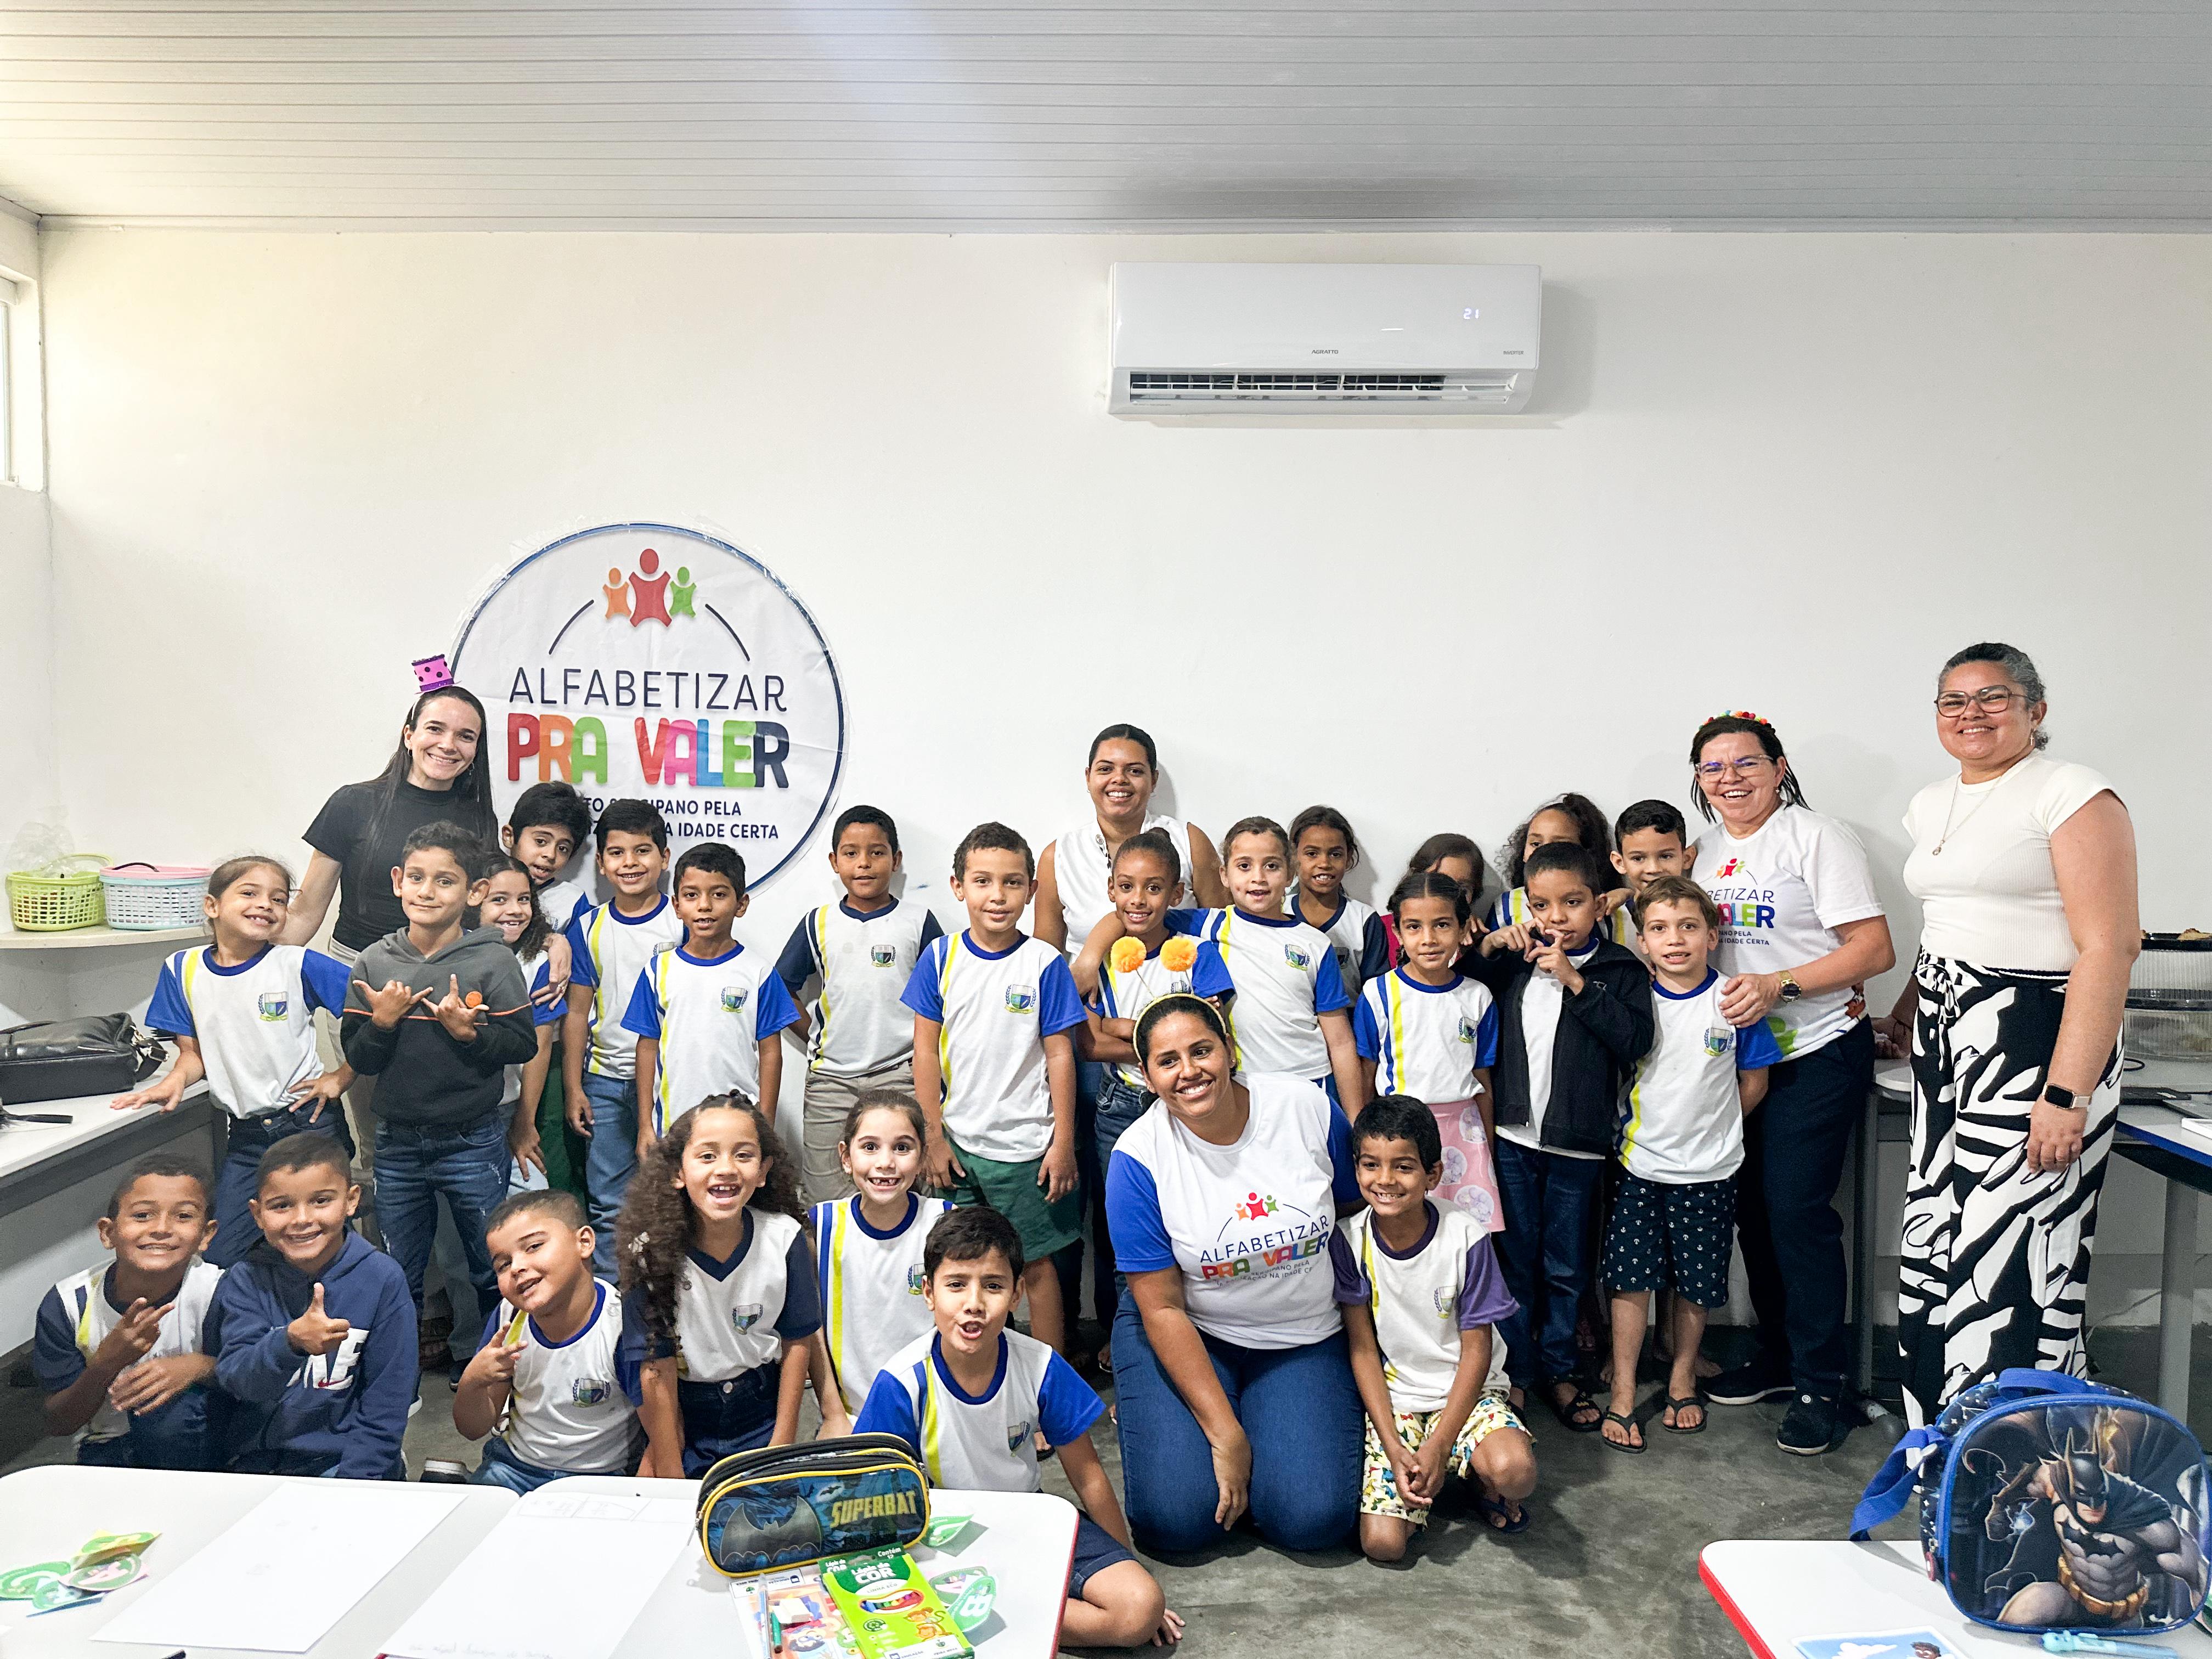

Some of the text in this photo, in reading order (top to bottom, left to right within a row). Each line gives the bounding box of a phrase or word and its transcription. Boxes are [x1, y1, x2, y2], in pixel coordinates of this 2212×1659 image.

[1463, 308, 1480, 320] 21
[509, 667, 787, 712] ALFABETIZAR
[507, 713, 790, 788] PRA VALER
[704, 800, 741, 816] PELA
[678, 823, 725, 838] IDADE
[730, 824, 778, 839] CERTA
[1717, 902, 1775, 929] ALER
[1200, 1215, 1329, 1263] ALFABETIZAR
[1201, 1258, 1251, 1280] PRA
[1262, 1231, 1329, 1267] VALER
[1282, 1268, 1302, 1278] IDADE
[830, 1491, 917, 1528] SUPERBAT
[855, 1566, 896, 1583] COR
